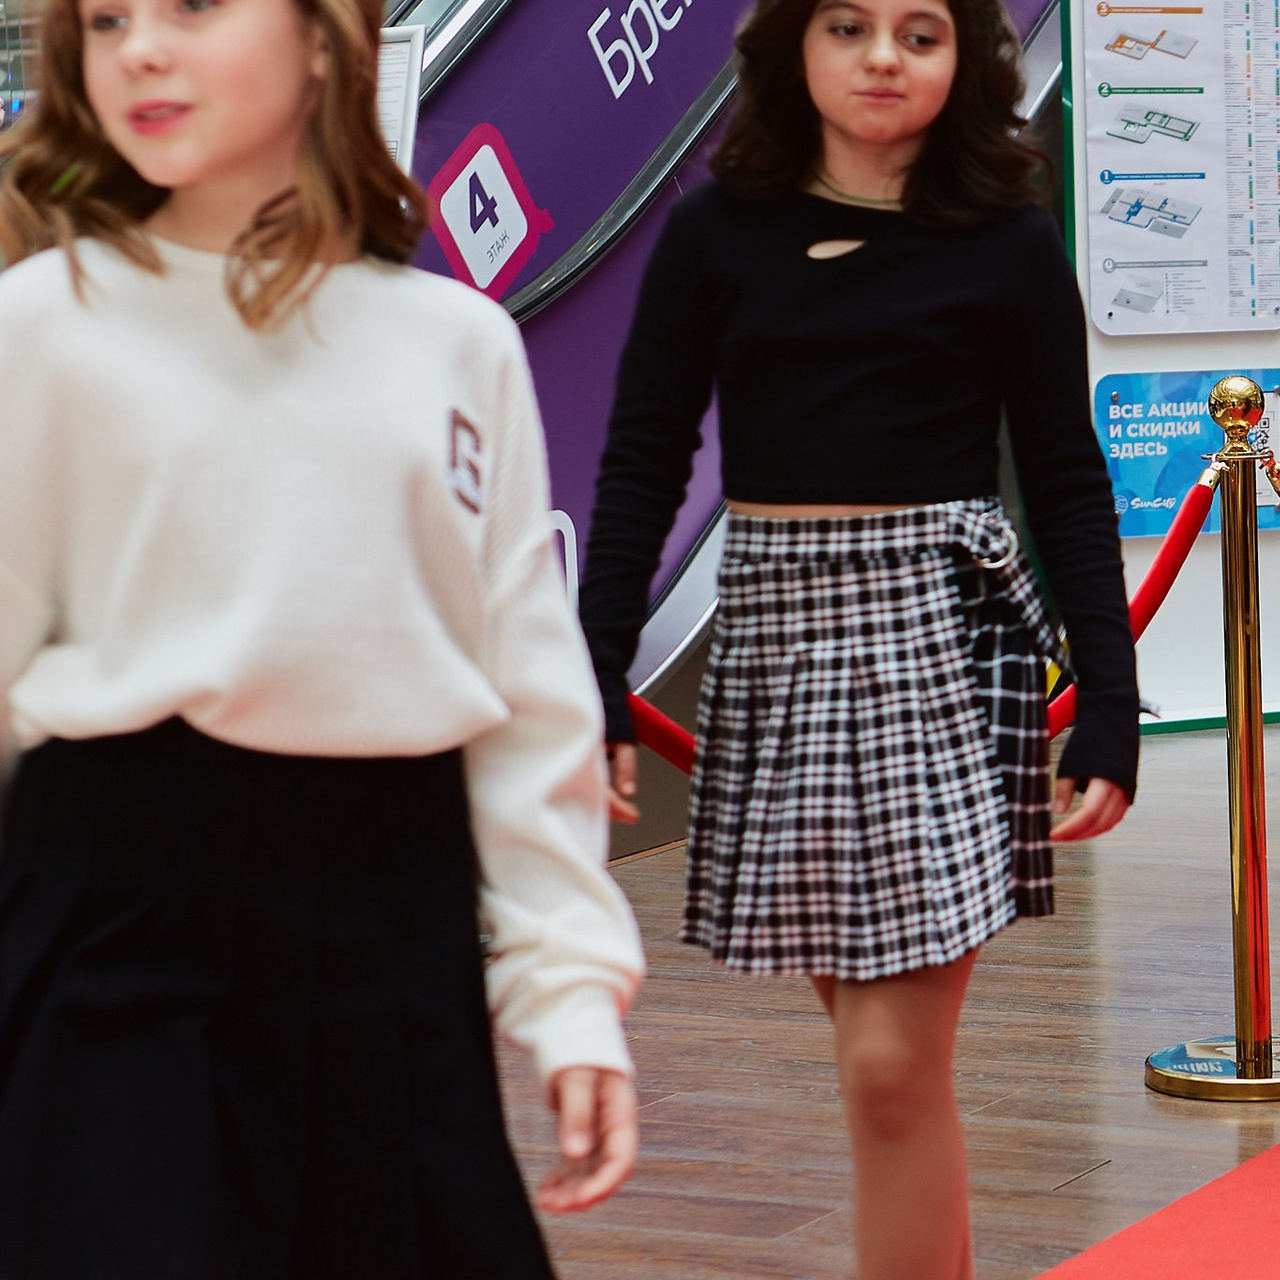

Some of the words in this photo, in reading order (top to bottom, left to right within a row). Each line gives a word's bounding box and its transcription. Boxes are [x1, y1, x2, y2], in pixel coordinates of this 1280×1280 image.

[468, 171, 500, 235] 4
[487, 229, 511, 263] ЭТАЖ
[1109, 404, 1143, 419] ВСЕ
[1147, 401, 1210, 419] АКЦИИ
[1109, 424, 1122, 438] И
[1126, 421, 1201, 439] СКИДКИ
[1109, 442, 1168, 459] ЗДЕСЬ
